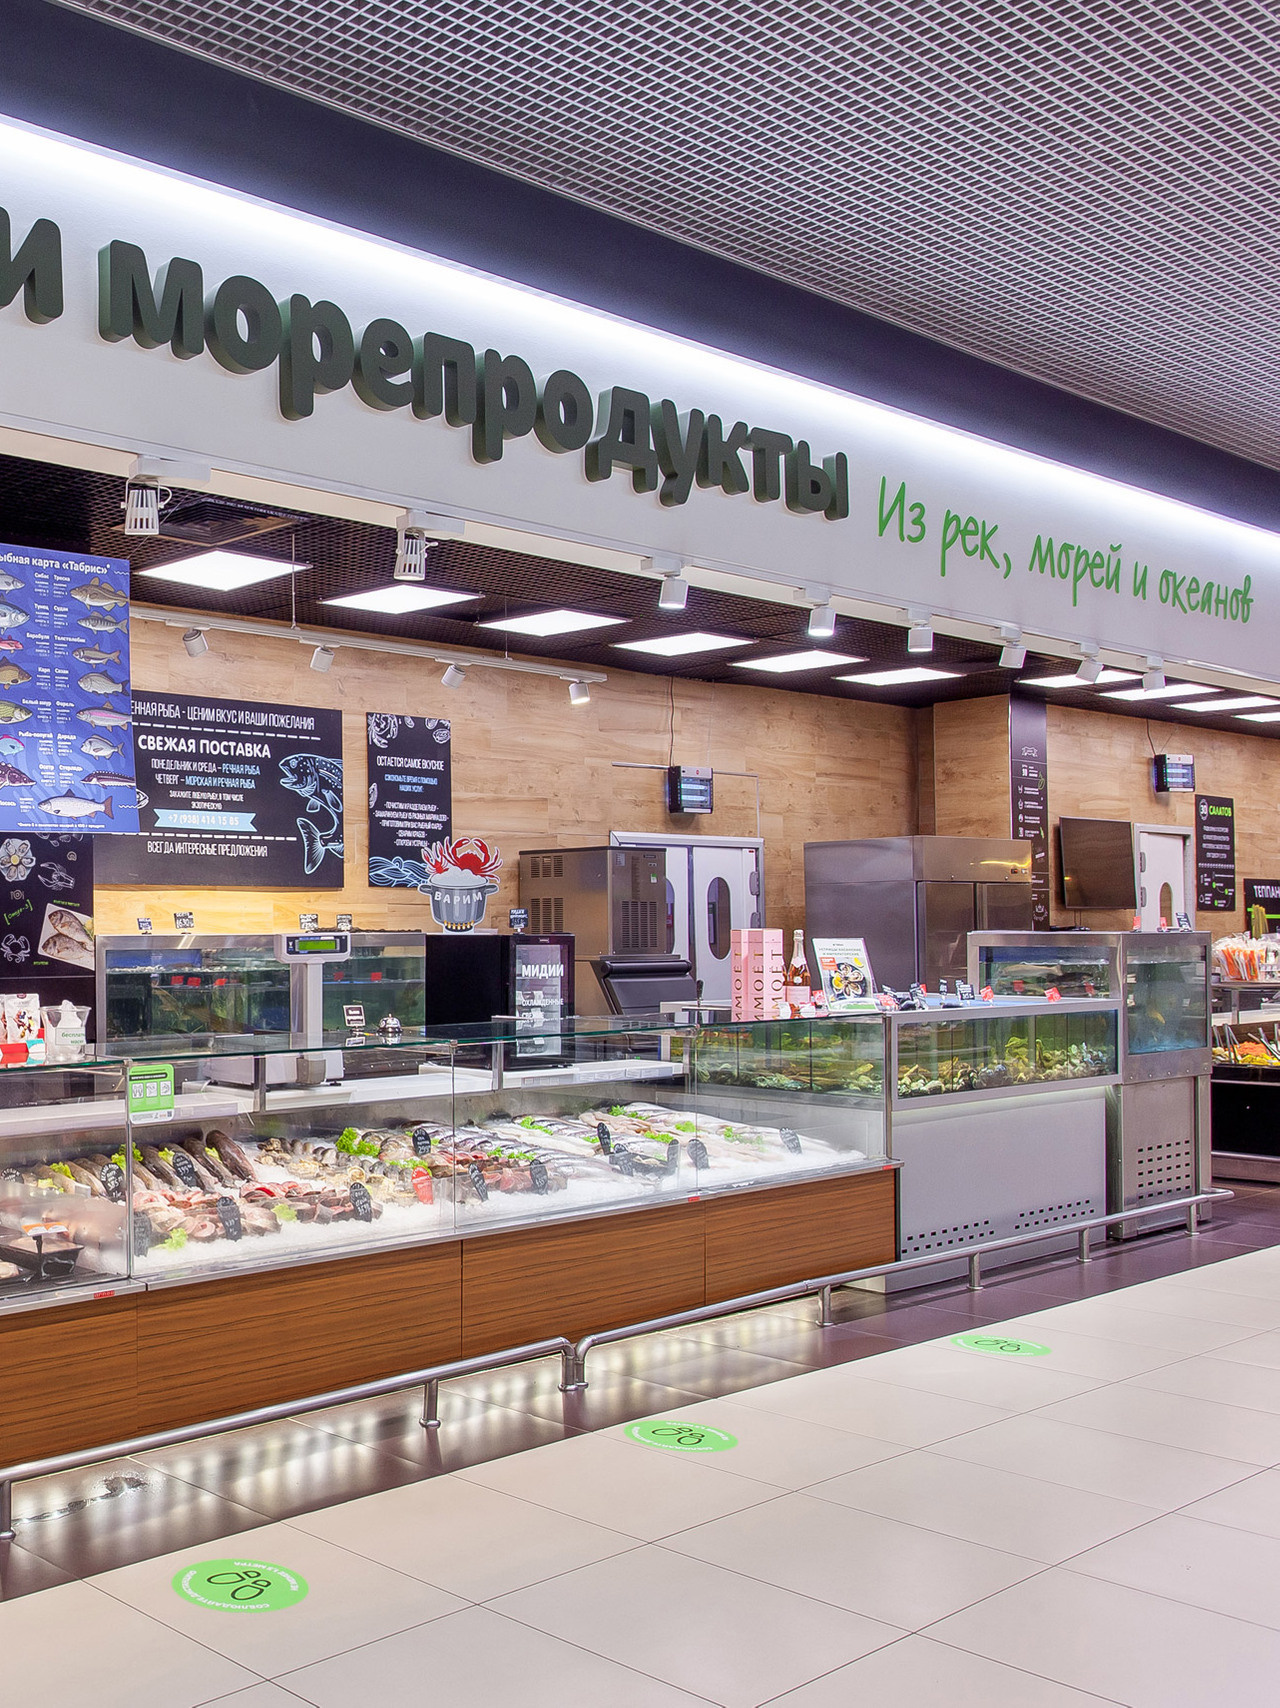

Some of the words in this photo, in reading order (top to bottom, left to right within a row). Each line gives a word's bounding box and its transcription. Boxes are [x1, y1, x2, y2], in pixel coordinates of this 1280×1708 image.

[97, 238, 849, 521] морепродукты
[877, 475, 927, 543] Из
[940, 509, 1012, 580] рек,
[1028, 533, 1122, 608] морей
[1133, 560, 1148, 601] и
[1158, 574, 1254, 624] океанов
[31, 557, 60, 569] карта
[158, 703, 181, 719] РЫБА
[187, 706, 215, 723] ЦЕНИМ
[216, 707, 237, 724] ВКУС
[238, 709, 244, 724] И
[245, 711, 268, 727] ВАШИ
[268, 713, 315, 731] ПОЖЕЛАНИЯ
[137, 734, 196, 754] СВЕЖАЯ
[199, 739, 271, 759] ПОСТАВКА
[175, 842, 218, 856] ИНТЕРЕСНЫЕ
[218, 843, 268, 857] ПРЕДЛОЖЕНИЯ
[433, 891, 483, 905] ВАРИМ
[521, 964, 564, 979] МИДИИ
